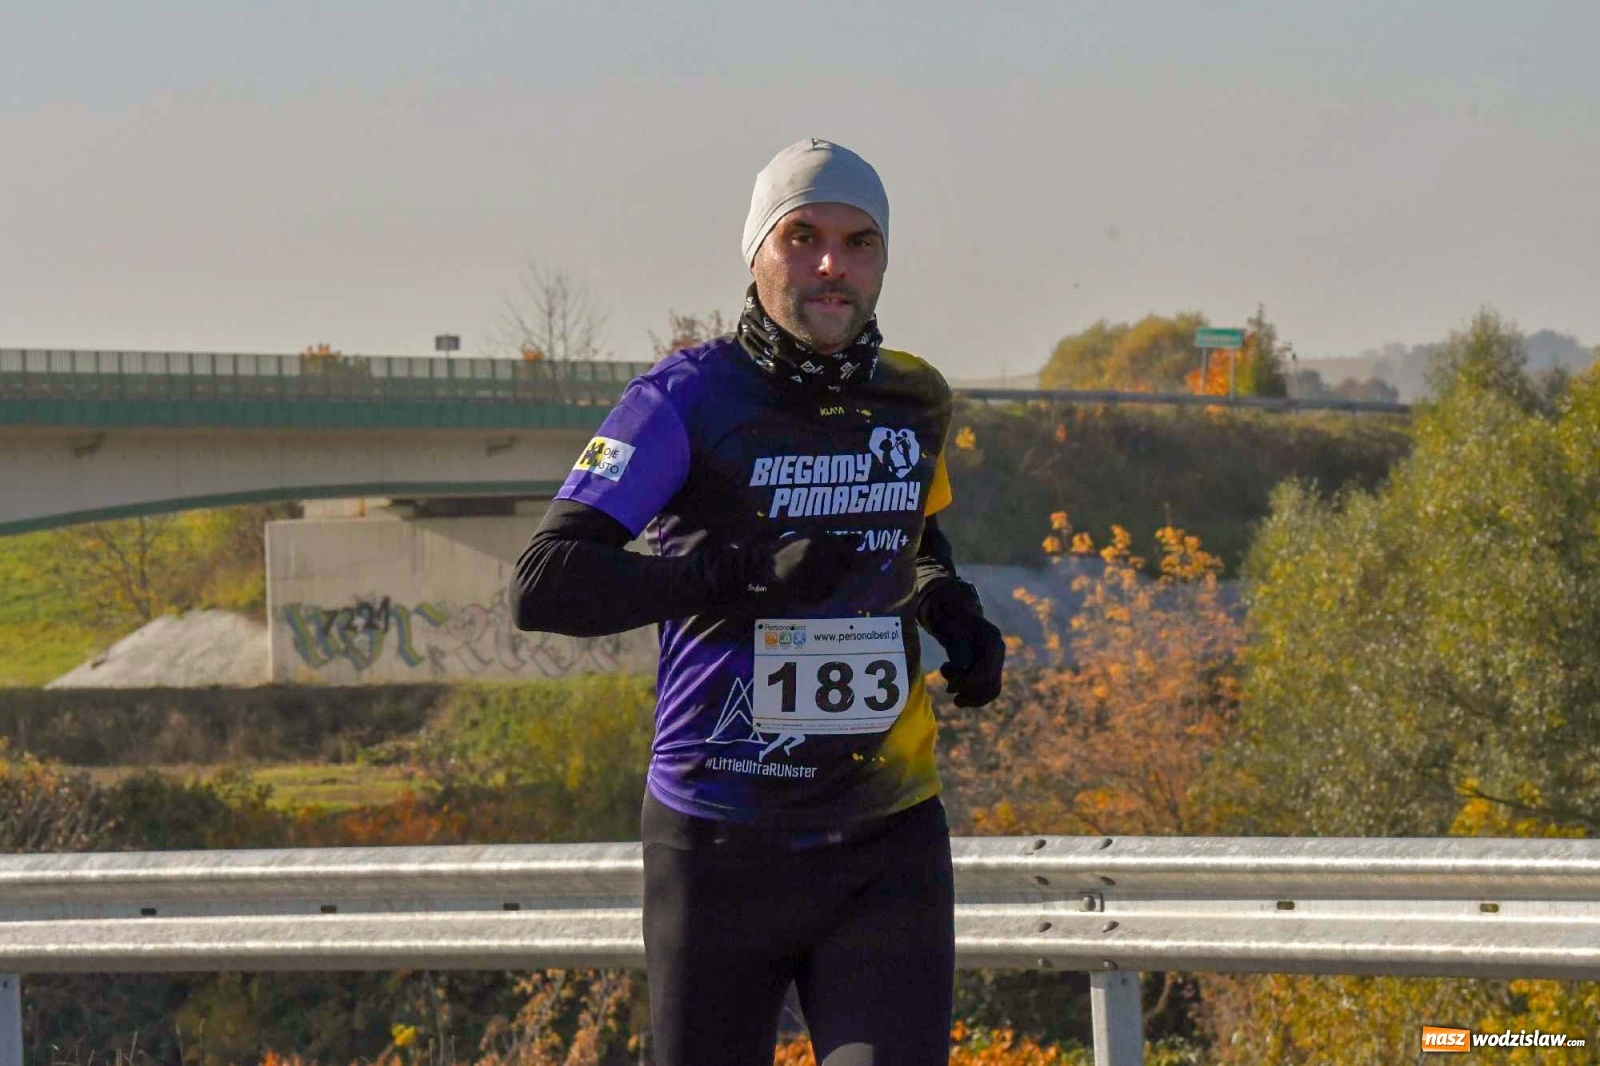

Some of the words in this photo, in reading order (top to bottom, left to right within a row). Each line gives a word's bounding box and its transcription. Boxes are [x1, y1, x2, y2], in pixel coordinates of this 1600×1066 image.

[749, 453, 872, 487] BIEGAMY
[768, 482, 921, 518] POMAGAMY
[814, 630, 899, 643] www.personalbest.pl
[767, 659, 900, 714] 183
[705, 757, 818, 778] #LittleUltraRUNster
